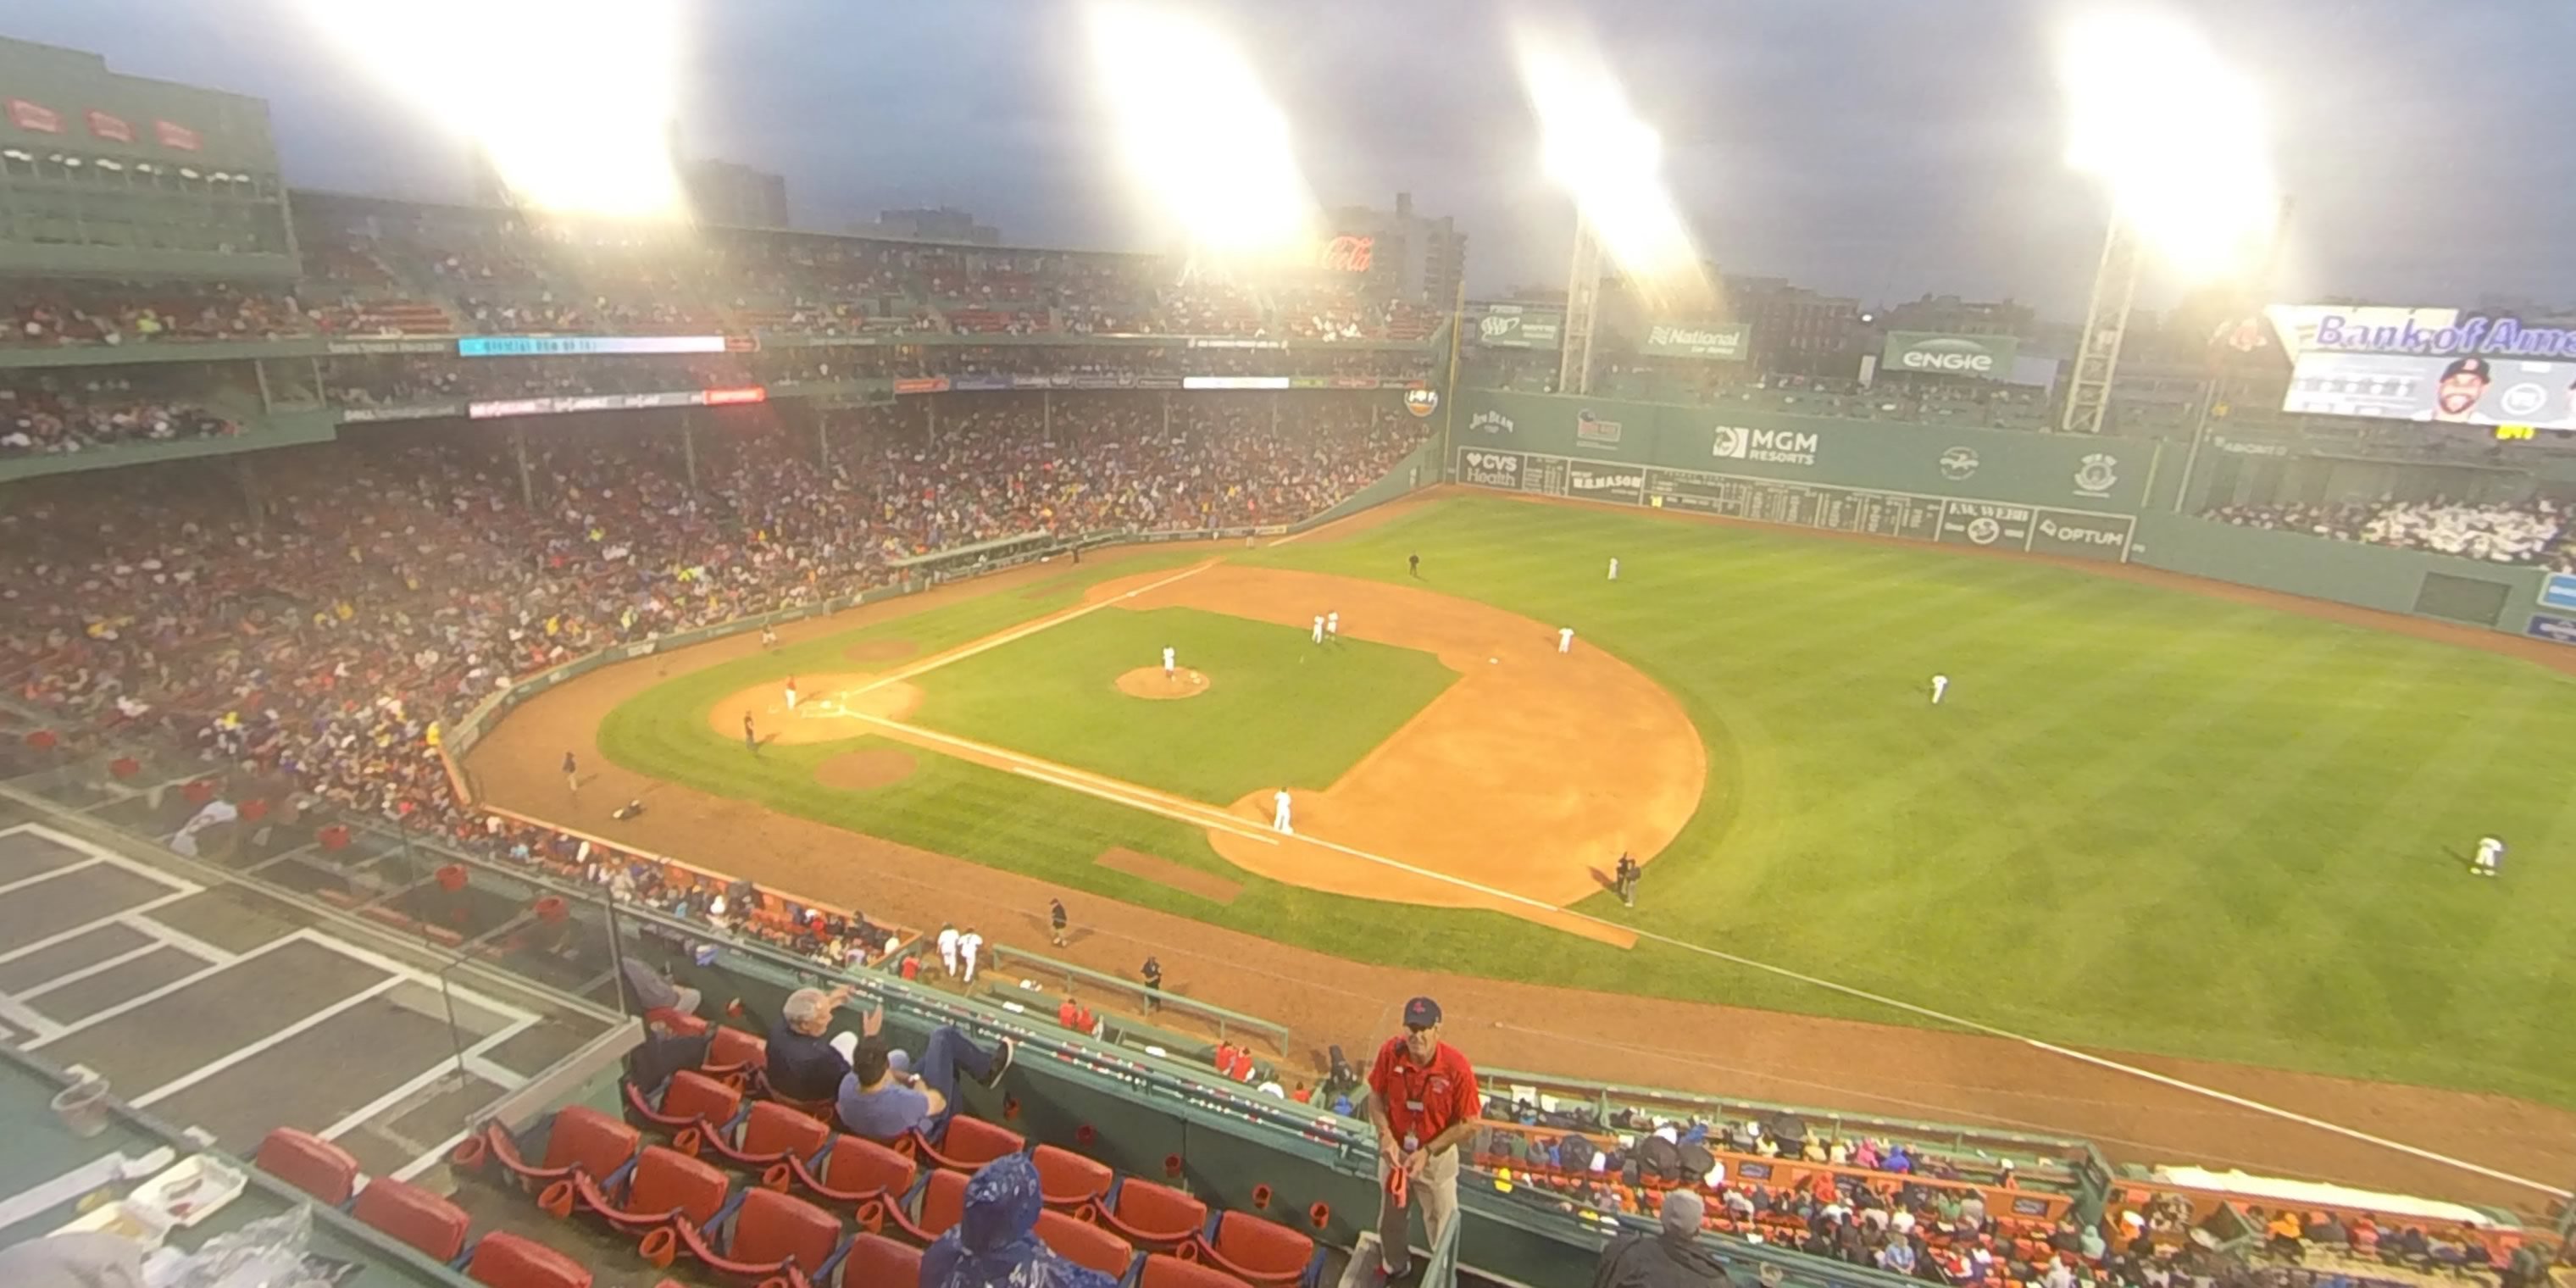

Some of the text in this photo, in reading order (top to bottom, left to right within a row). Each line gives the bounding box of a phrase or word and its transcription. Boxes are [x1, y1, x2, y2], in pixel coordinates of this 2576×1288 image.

[1668, 328, 1740, 347] National
[2317, 314, 2434, 353] Bank
[1751, 428, 1818, 453] MGM
[1482, 453, 1518, 472] CVS
[1749, 449, 1815, 465] RESORTS
[1466, 467, 1516, 487] Health
[2057, 527, 2124, 547] OPTUM
